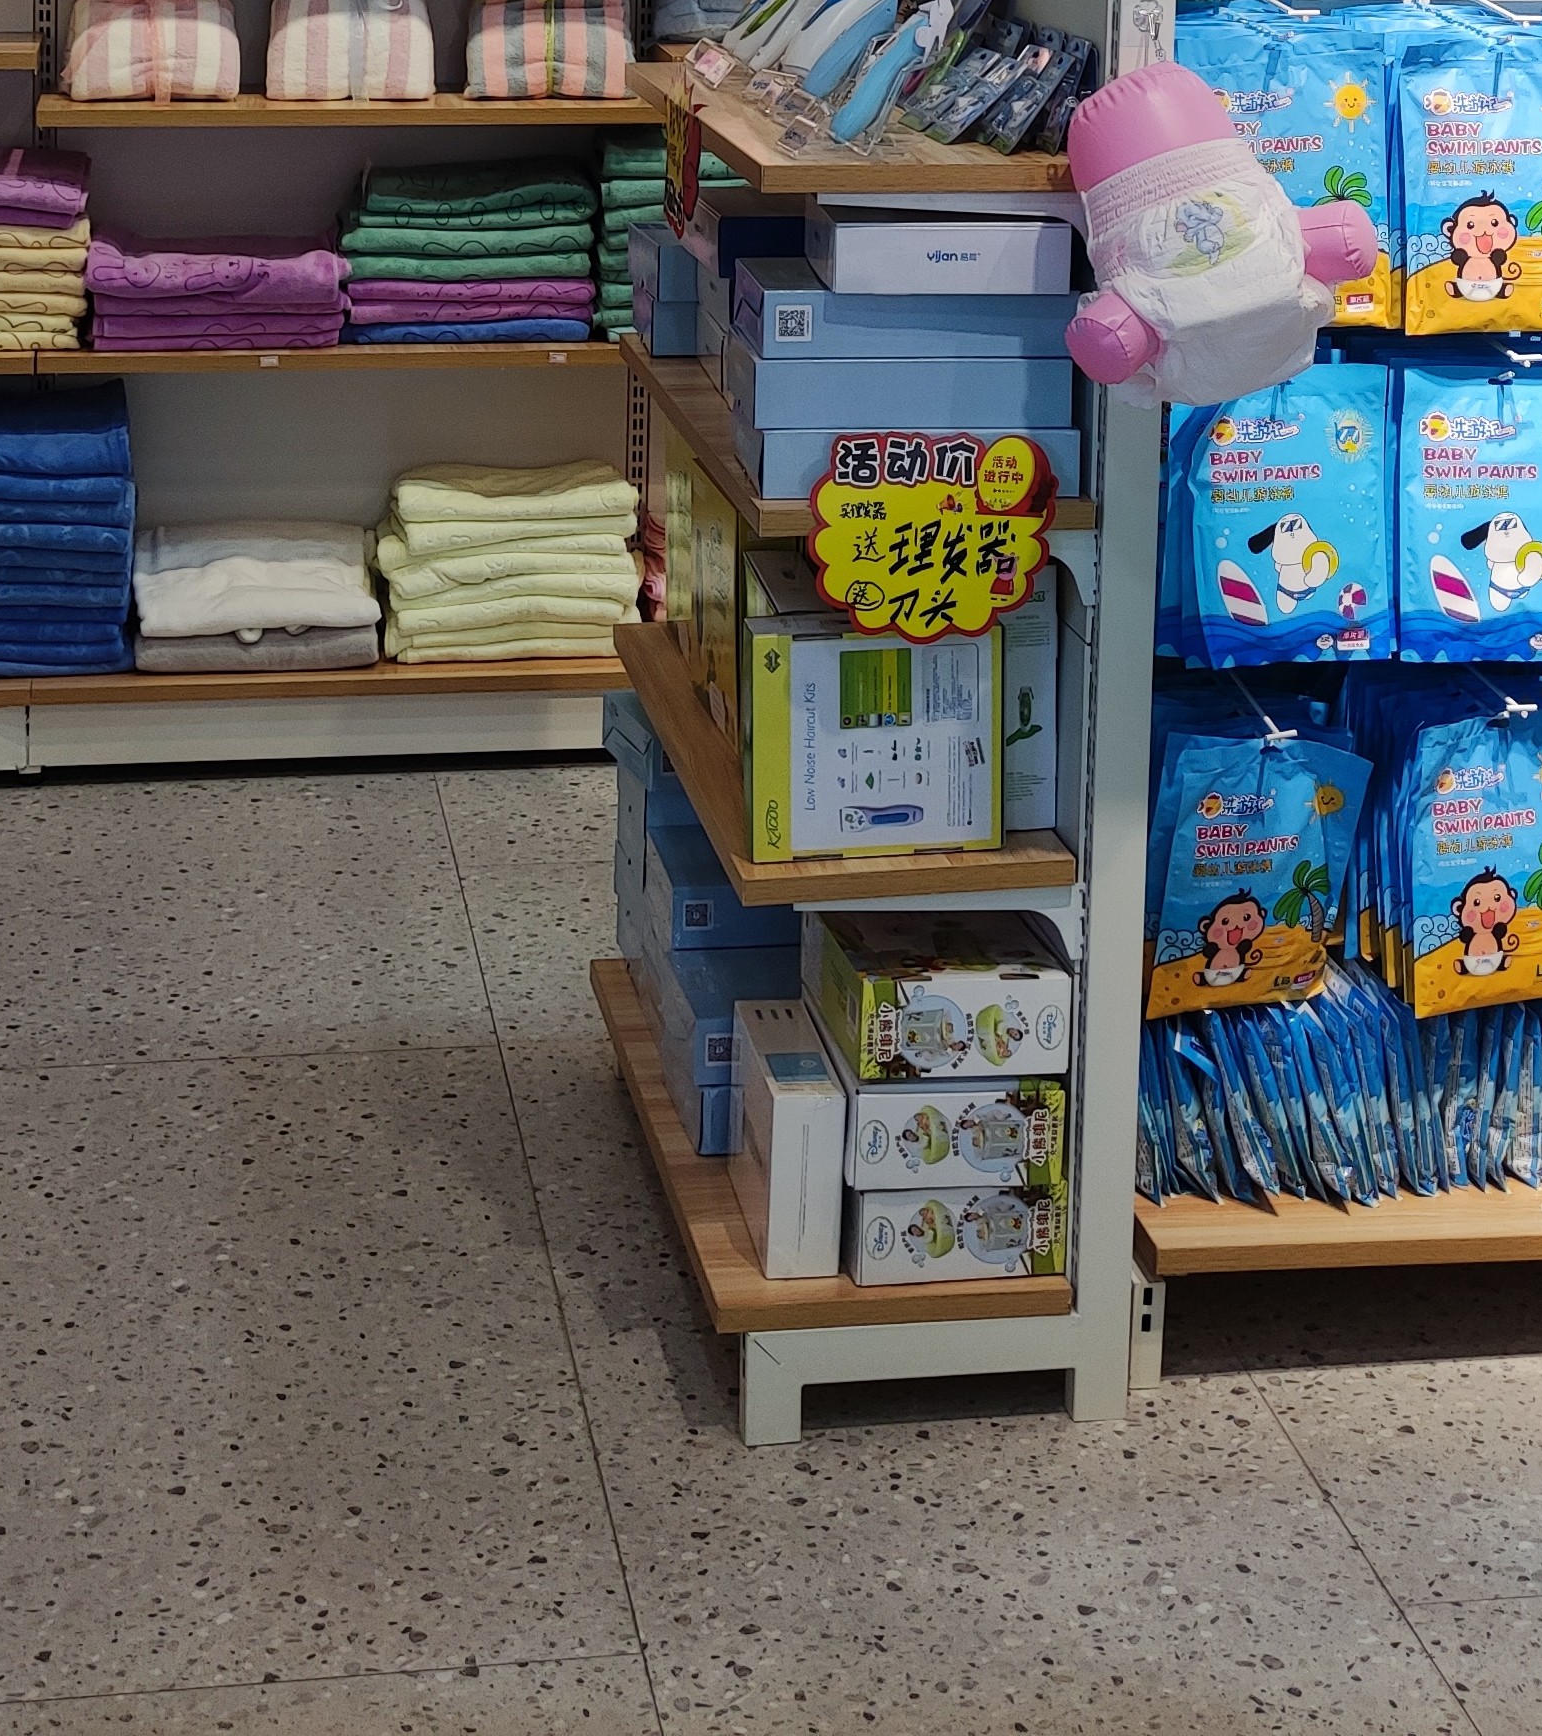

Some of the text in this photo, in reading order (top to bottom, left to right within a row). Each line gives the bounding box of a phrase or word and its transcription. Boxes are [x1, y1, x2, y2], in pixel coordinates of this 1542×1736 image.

[1426, 122, 1482, 137] BABY
[1261, 136, 1323, 153] PANTS
[1426, 139, 1542, 155] SWIM PANTS
[837, 437, 978, 486] 活动价
[992, 455, 1018, 469] 活动
[1209, 448, 1263, 465] BABY
[1423, 447, 1477, 462] BABY
[983, 470, 1024, 484] 进行中
[1211, 464, 1322, 484] SWIM PANTS
[1423, 464, 1538, 479] SWIM PANTS
[803, 682, 816, 811] Low Noise Haircut Kits
[1432, 798, 1483, 816] BABY
[1433, 809, 1535, 835] SWIM PANTS
[1196, 824, 1248, 841] BABY
[1195, 835, 1300, 859] SWIM PANTS
[878, 1004, 893, 1061] 小熊维尼
[1031, 1109, 1048, 1164] 小熊维尼
[1034, 1199, 1051, 1255] 小熊维尼
